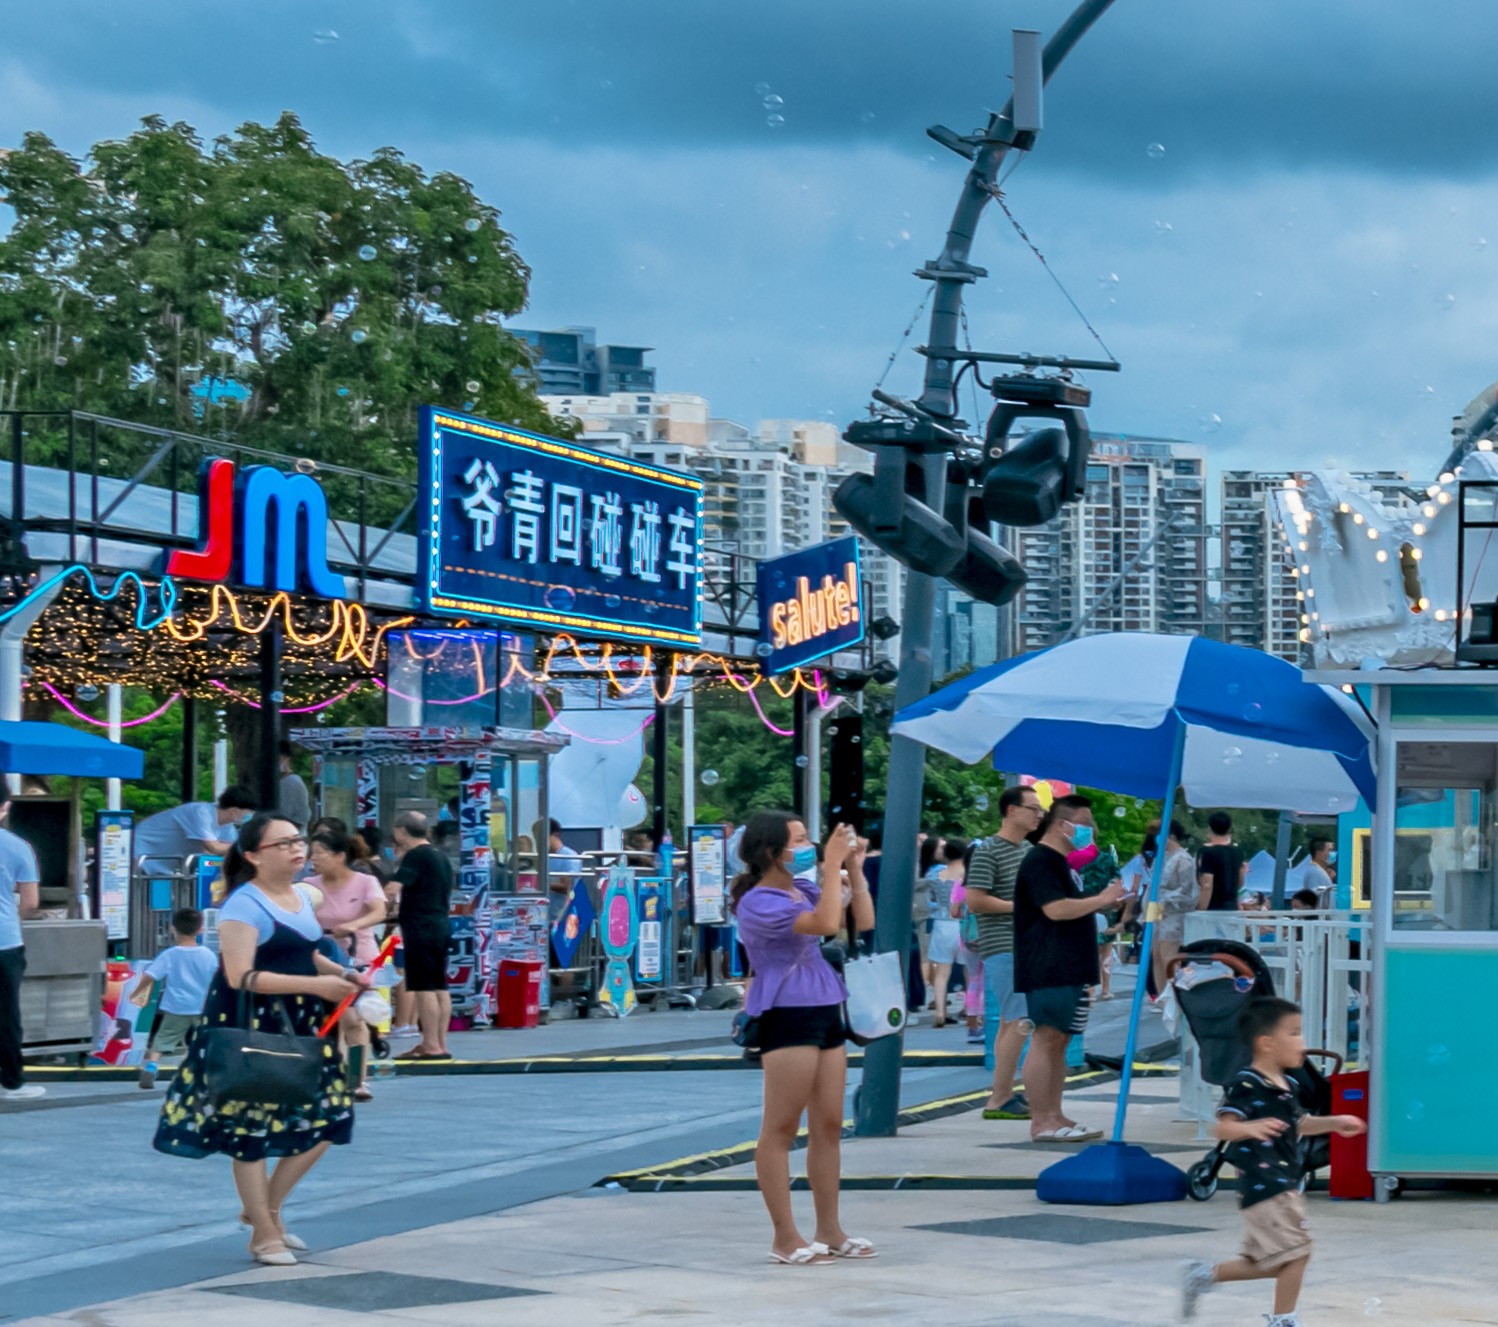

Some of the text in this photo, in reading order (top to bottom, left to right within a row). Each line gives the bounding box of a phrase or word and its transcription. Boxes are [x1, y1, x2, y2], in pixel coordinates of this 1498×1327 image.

[461, 457, 696, 590] 爷青回碰碰车
[769, 561, 860, 650] salute!
